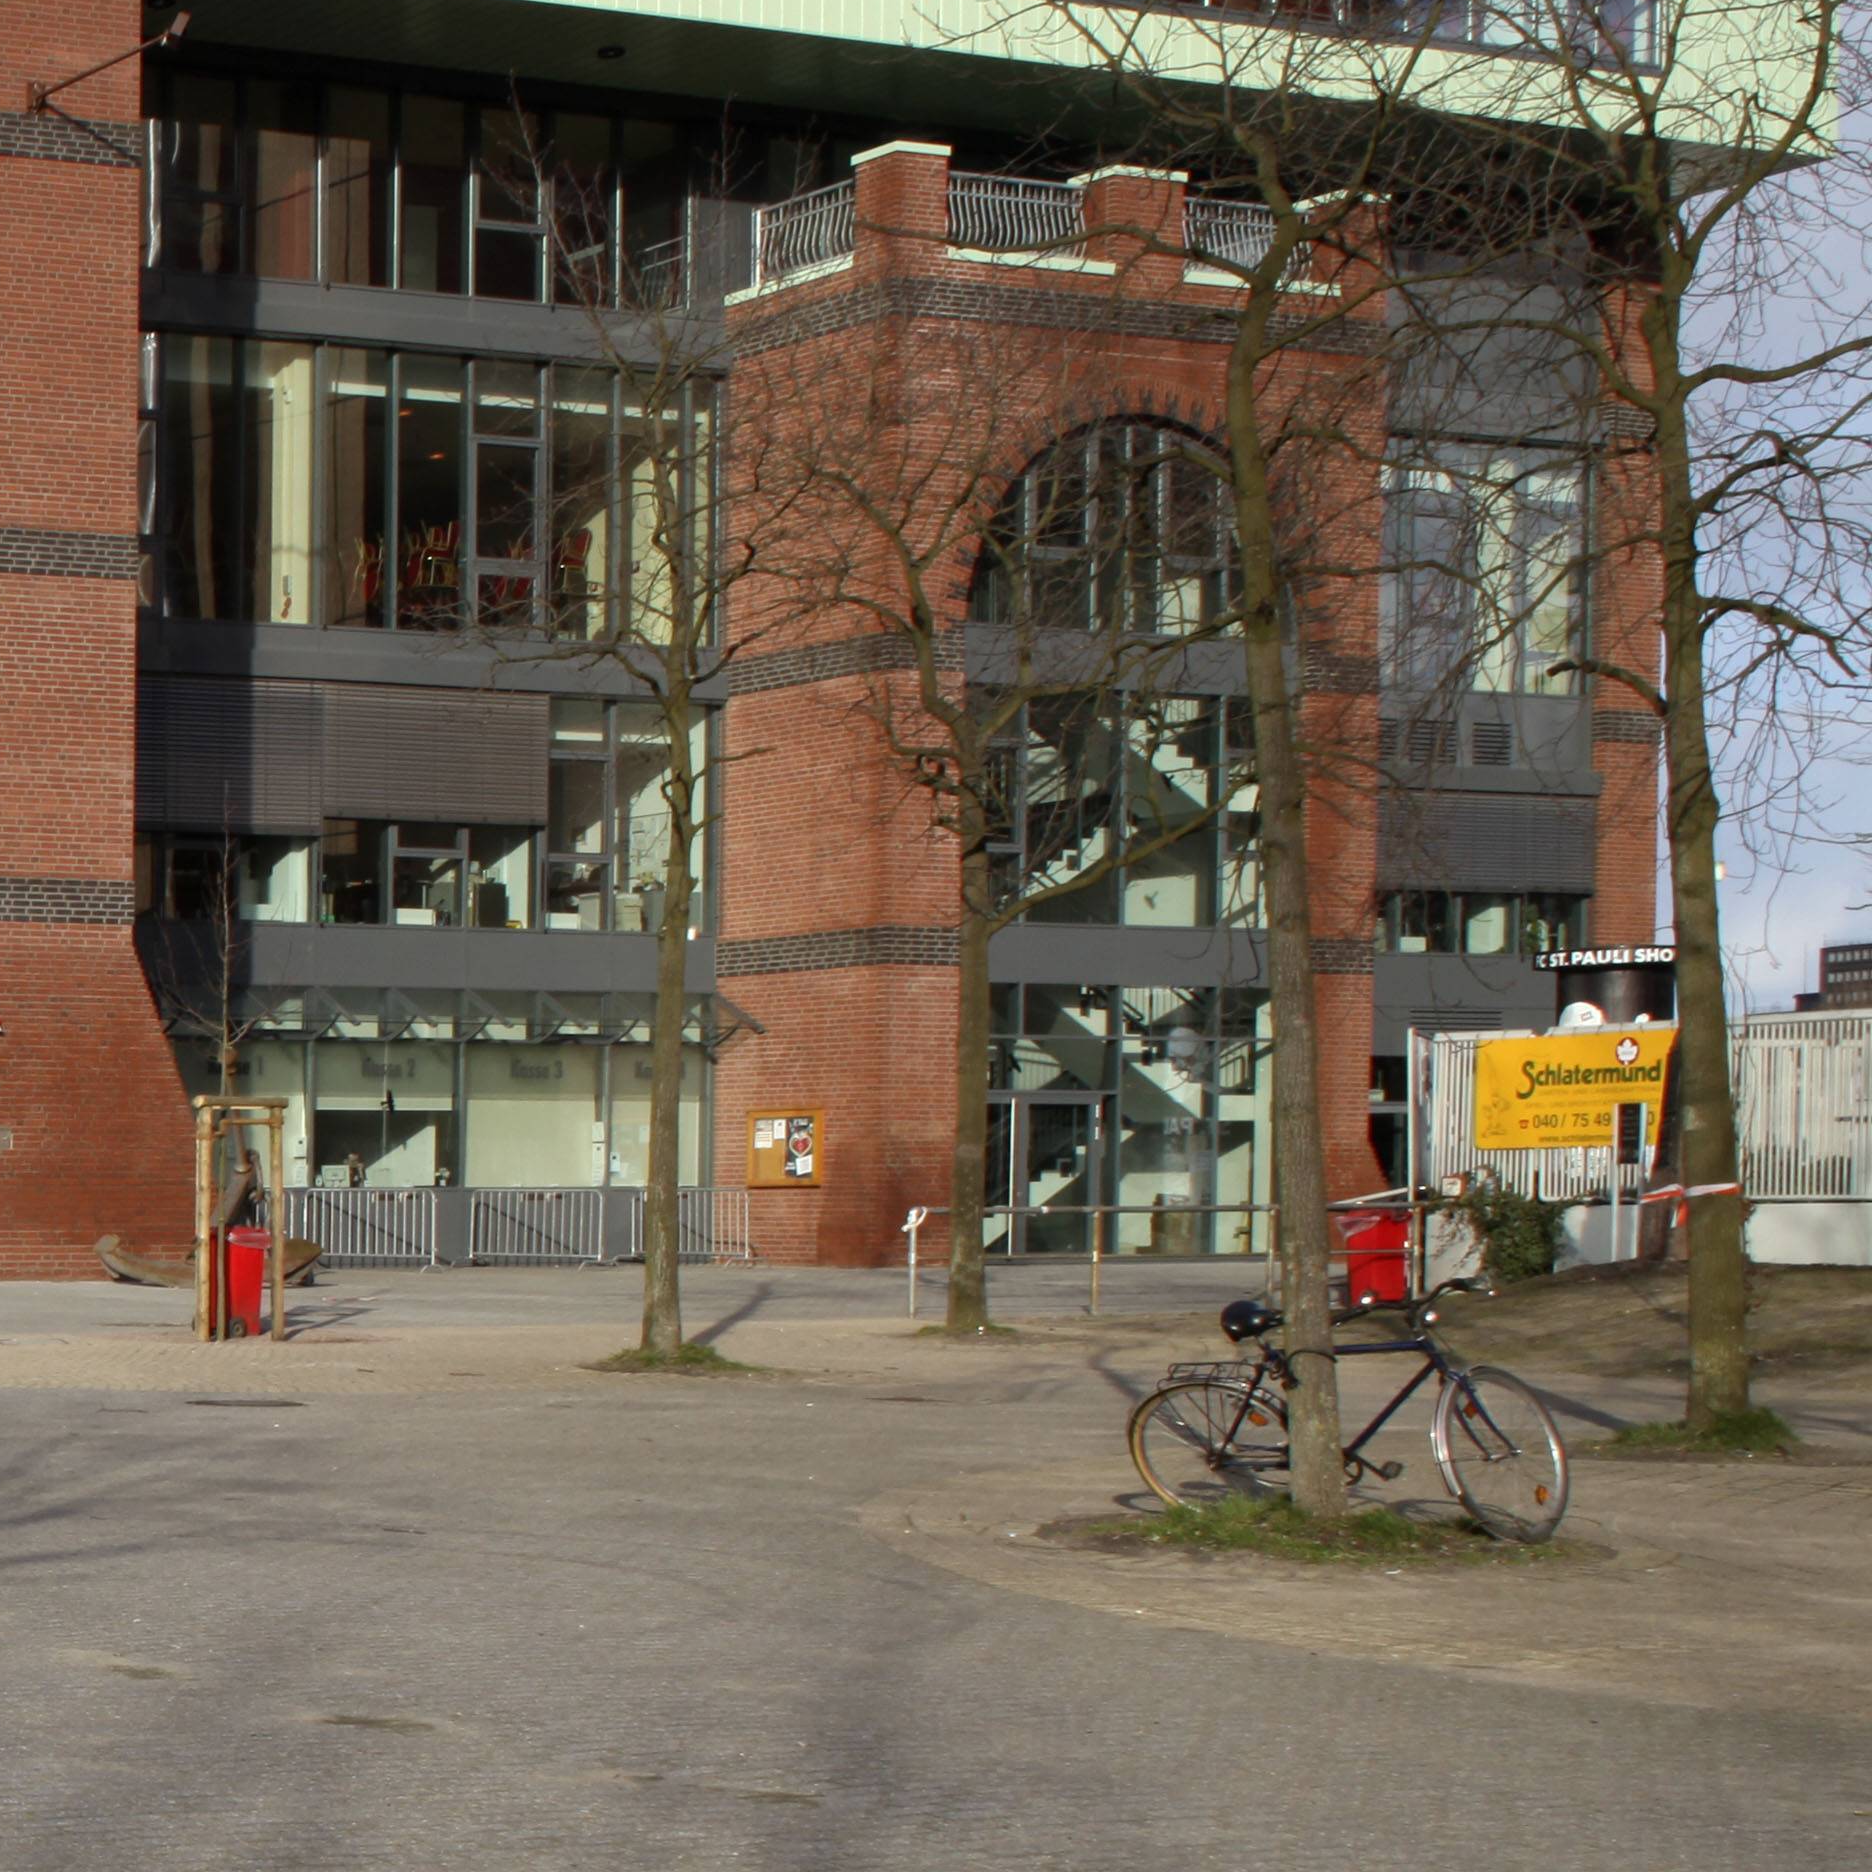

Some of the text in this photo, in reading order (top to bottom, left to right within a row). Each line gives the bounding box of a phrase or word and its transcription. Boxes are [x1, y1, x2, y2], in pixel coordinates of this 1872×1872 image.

[1549, 952, 1569, 968] ST.
[1571, 949, 1630, 966] PAULI
[1634, 947, 1675, 963] SHO
[1516, 1060, 1662, 1099] Schlatermund
[1532, 1114, 1557, 1129] 040
[1572, 1112, 1589, 1128] 75
[1594, 1112, 1611, 1127] 49
